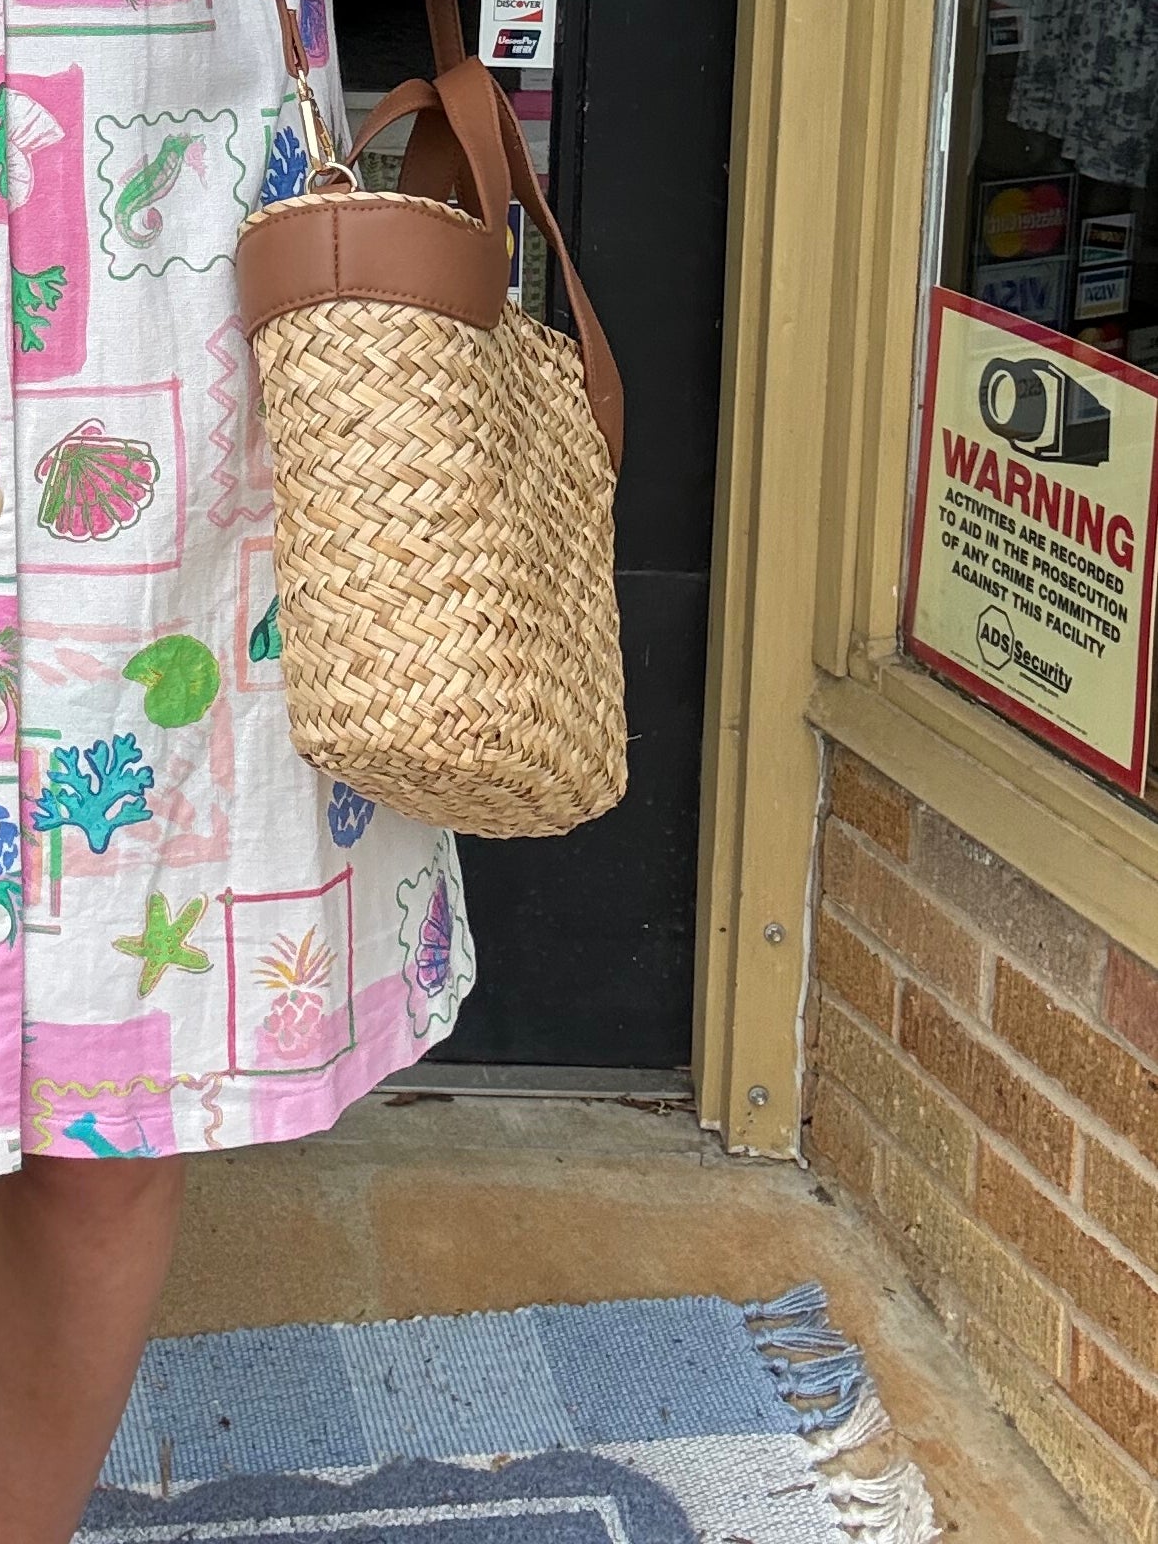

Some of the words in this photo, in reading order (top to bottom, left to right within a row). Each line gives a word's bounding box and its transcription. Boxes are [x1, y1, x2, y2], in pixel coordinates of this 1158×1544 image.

[496, 0, 541, 9] DISCOVER
[942, 427, 1134, 573] WARNING
[944, 487, 1016, 535] ACTIVITIES
[1018, 525, 1046, 552] ARE
[1049, 541, 1124, 595] RECORDED
[938, 505, 956, 527] TO
[959, 517, 982, 541] AID
[985, 529, 999, 550] IN
[1003, 538, 1029, 566] THE
[1032, 557, 1128, 623] PROSECUTION
[941, 531, 960, 551] OF
[961, 542, 989, 567] ANY
[992, 558, 1034, 594] CRIME
[1038, 584, 1121, 643] COMMITTED
[951, 560, 1009, 602] AGAINST
[1012, 591, 1042, 623] THIS
[1045, 611, 1106, 659] FACILITY
[979, 623, 1010, 656] ADS
[1014, 640, 1073, 688] Security
